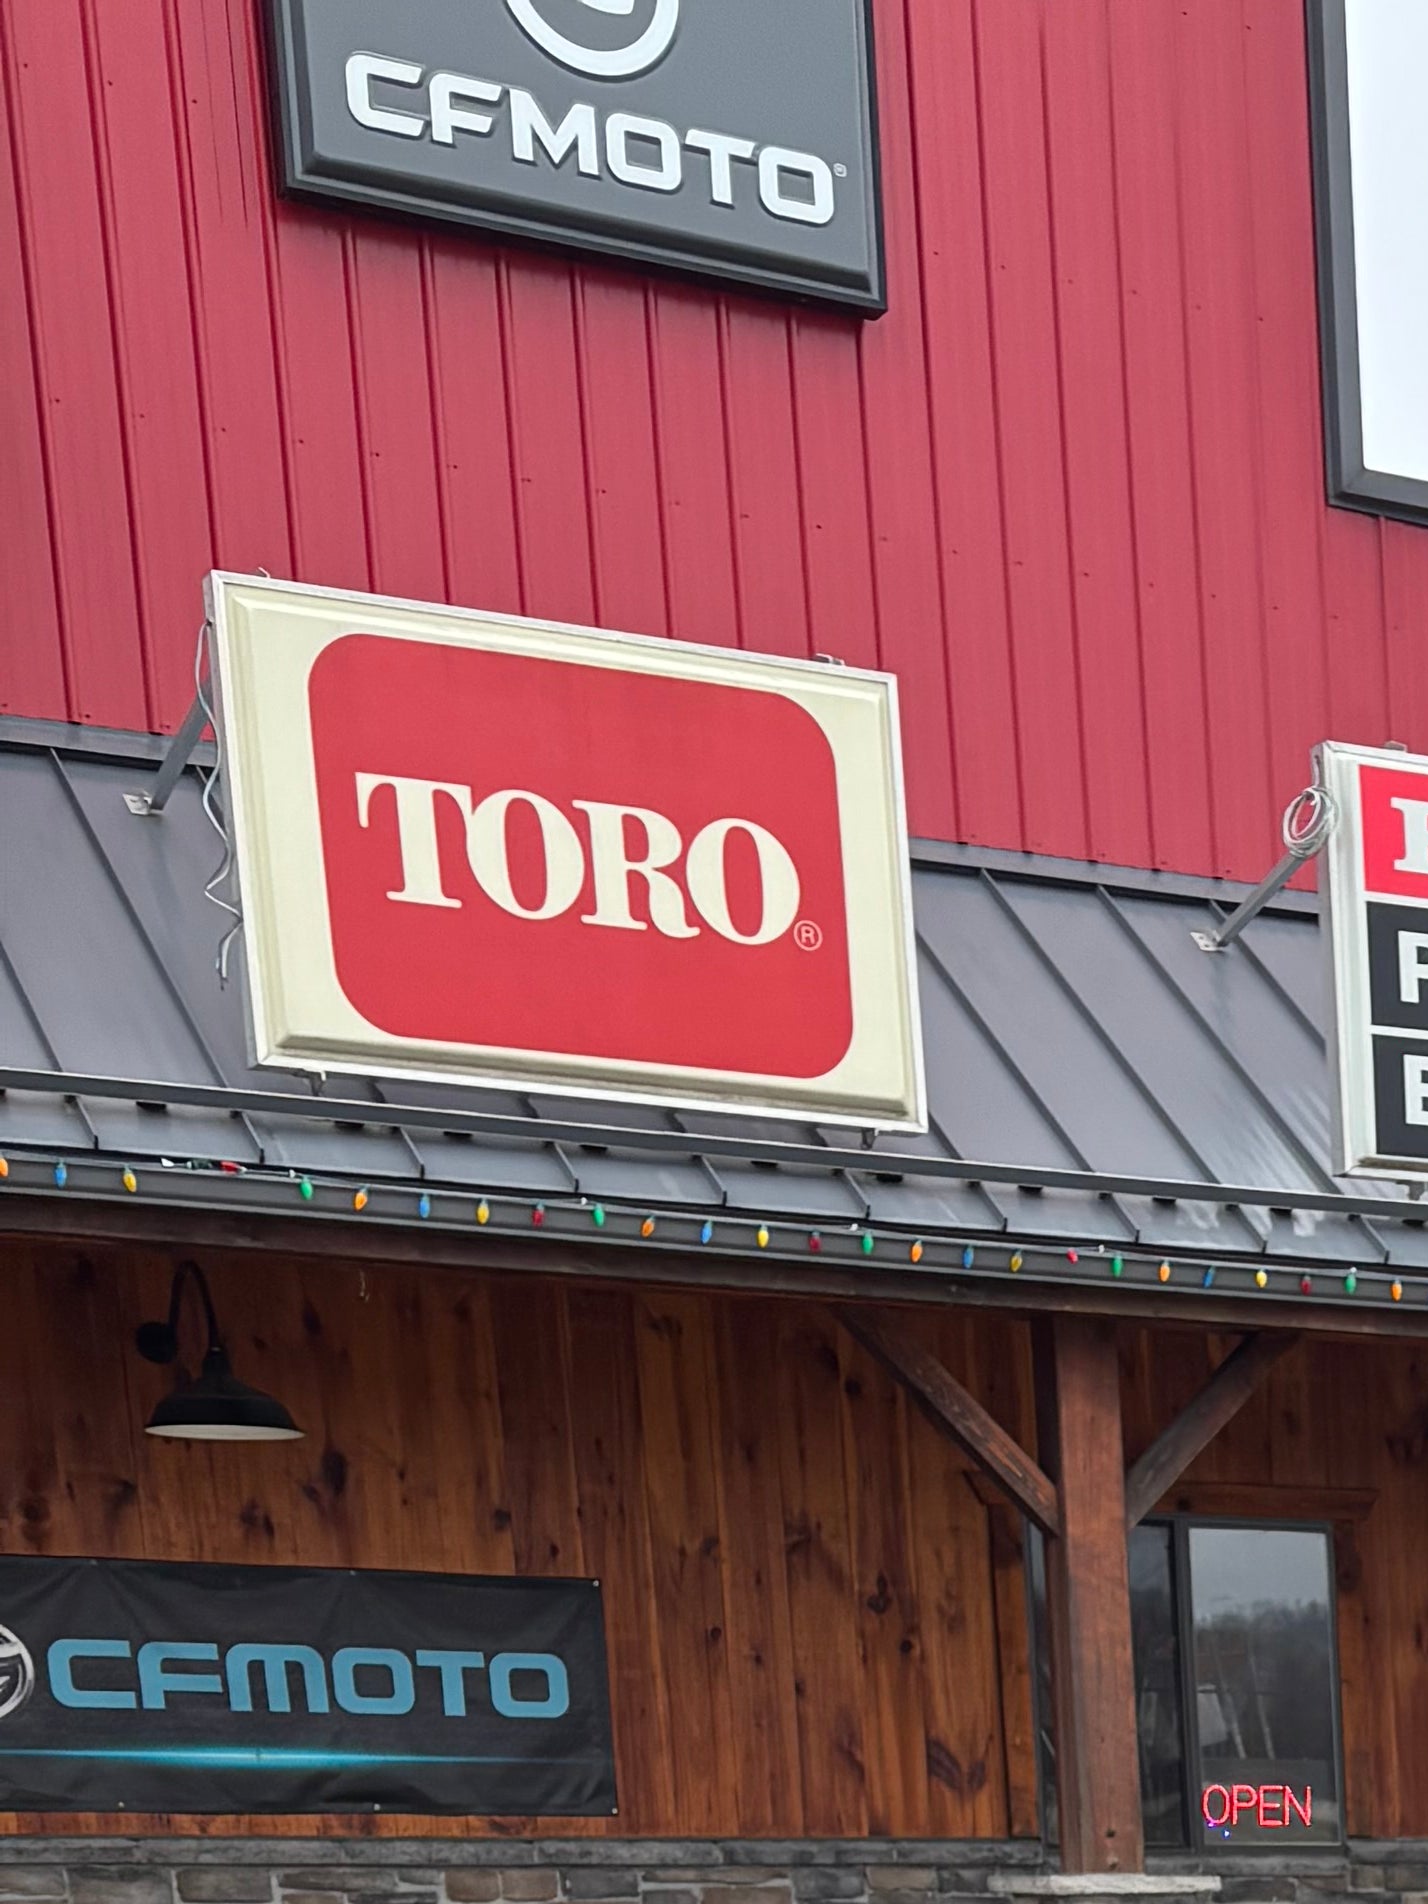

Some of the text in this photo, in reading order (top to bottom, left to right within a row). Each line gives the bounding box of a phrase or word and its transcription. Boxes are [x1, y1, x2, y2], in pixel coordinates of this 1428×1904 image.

[344, 51, 837, 226] CFMOTO
[355, 771, 801, 946] TORO
[47, 1638, 571, 1719] CFMOTO
[1201, 1784, 1312, 1829] OPEN
